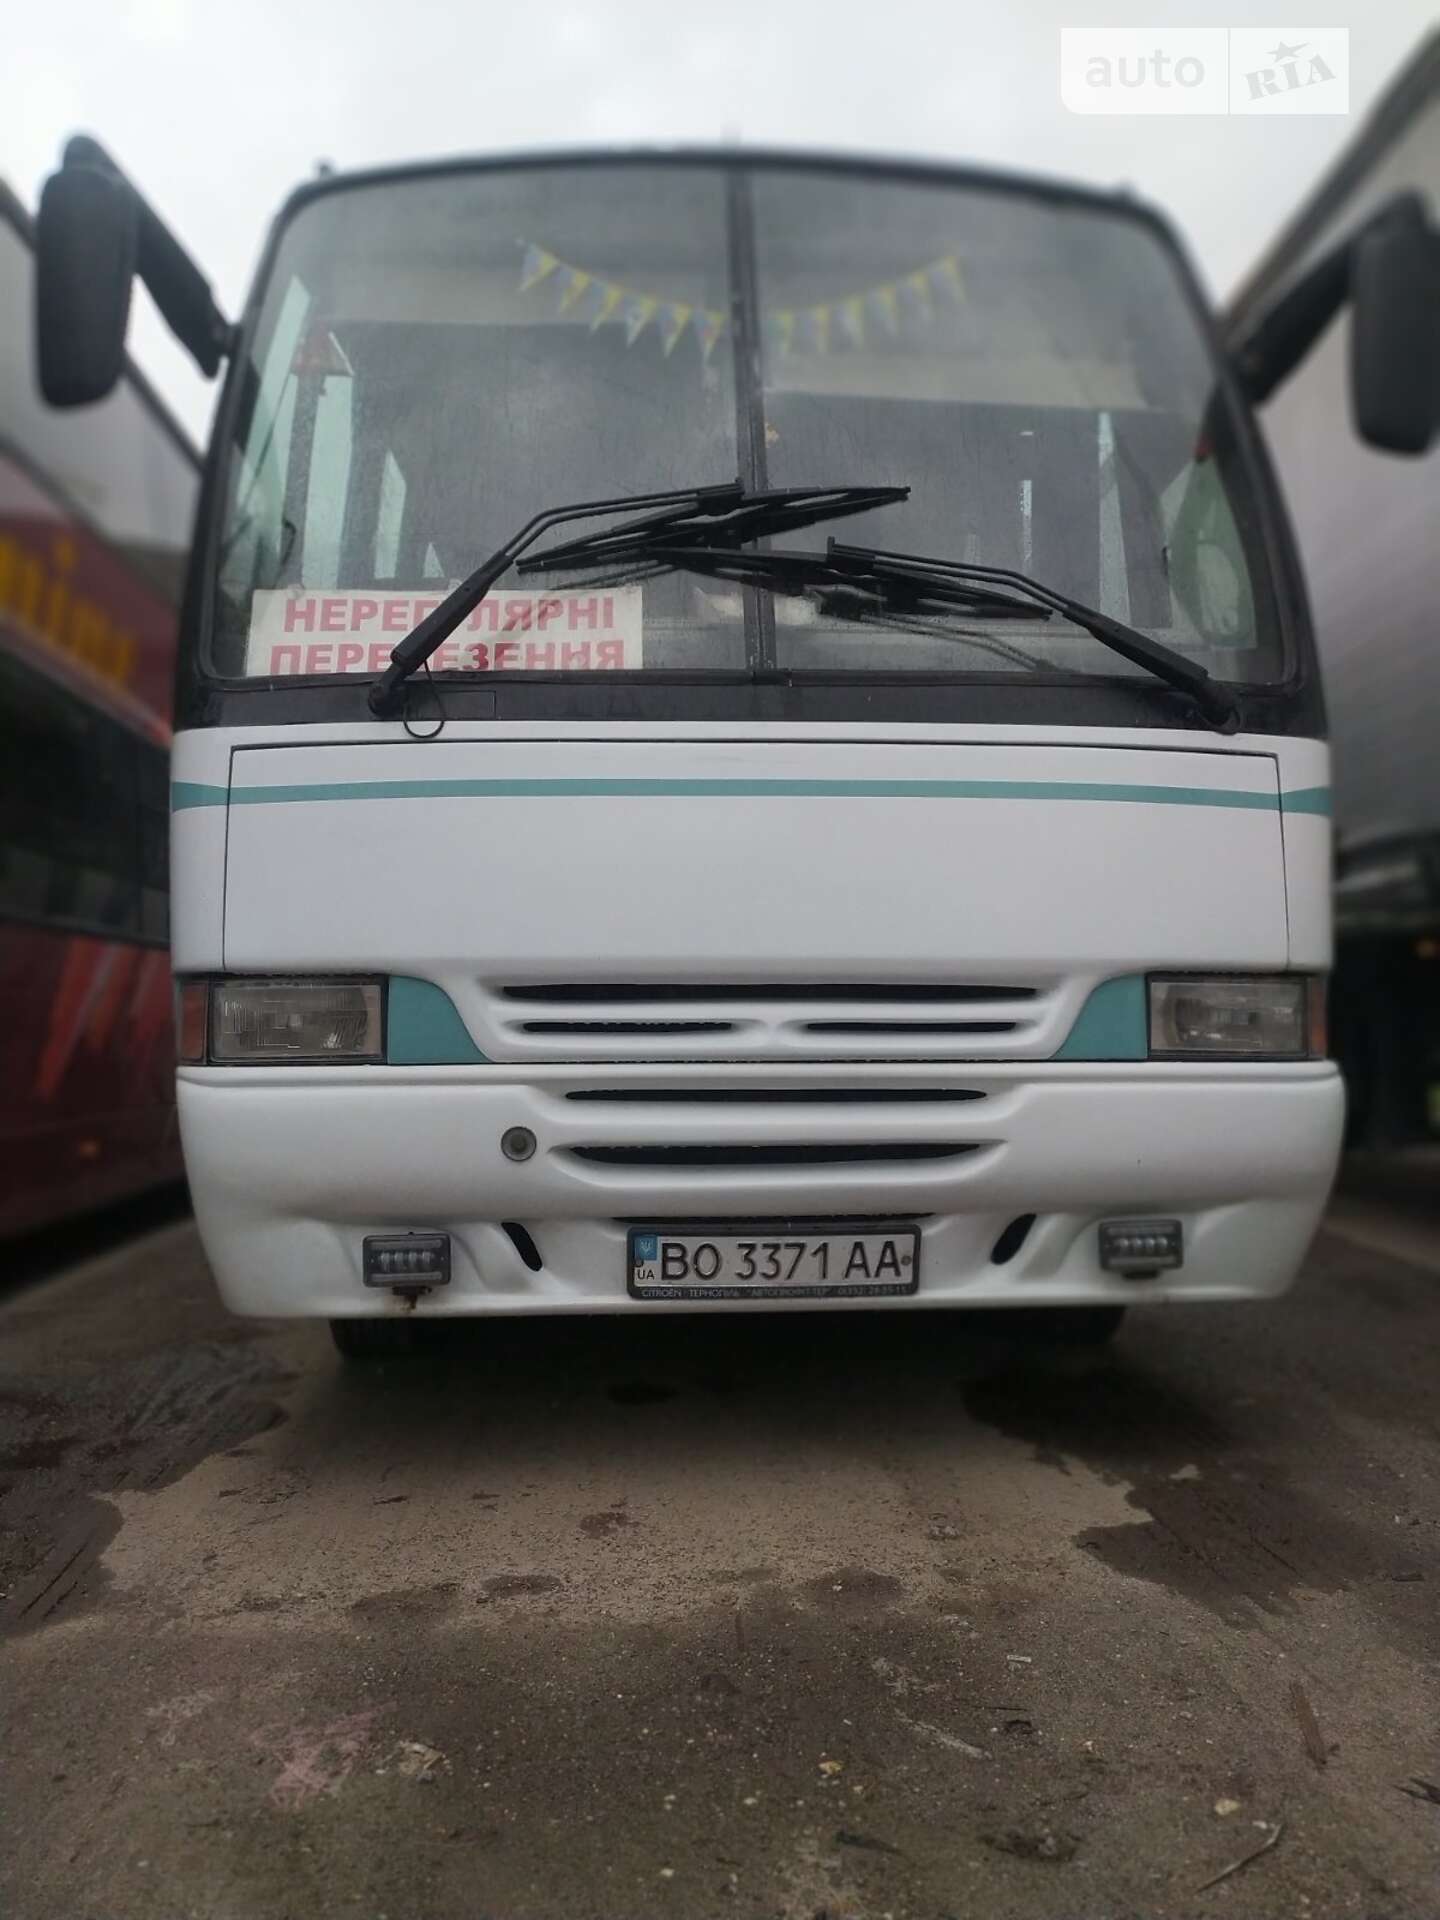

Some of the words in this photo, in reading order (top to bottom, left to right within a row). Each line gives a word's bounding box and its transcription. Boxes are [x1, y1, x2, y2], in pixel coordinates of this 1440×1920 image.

[284, 597, 613, 633] НЕРЕГЛЯРНІ
[270, 640, 624, 675] ПЕРЕЕЗЕННЯ
[637, 1269, 655, 1280] UA
[661, 1242, 721, 1281] BO
[735, 1241, 830, 1281] 3371
[844, 1240, 902, 1279] AA
